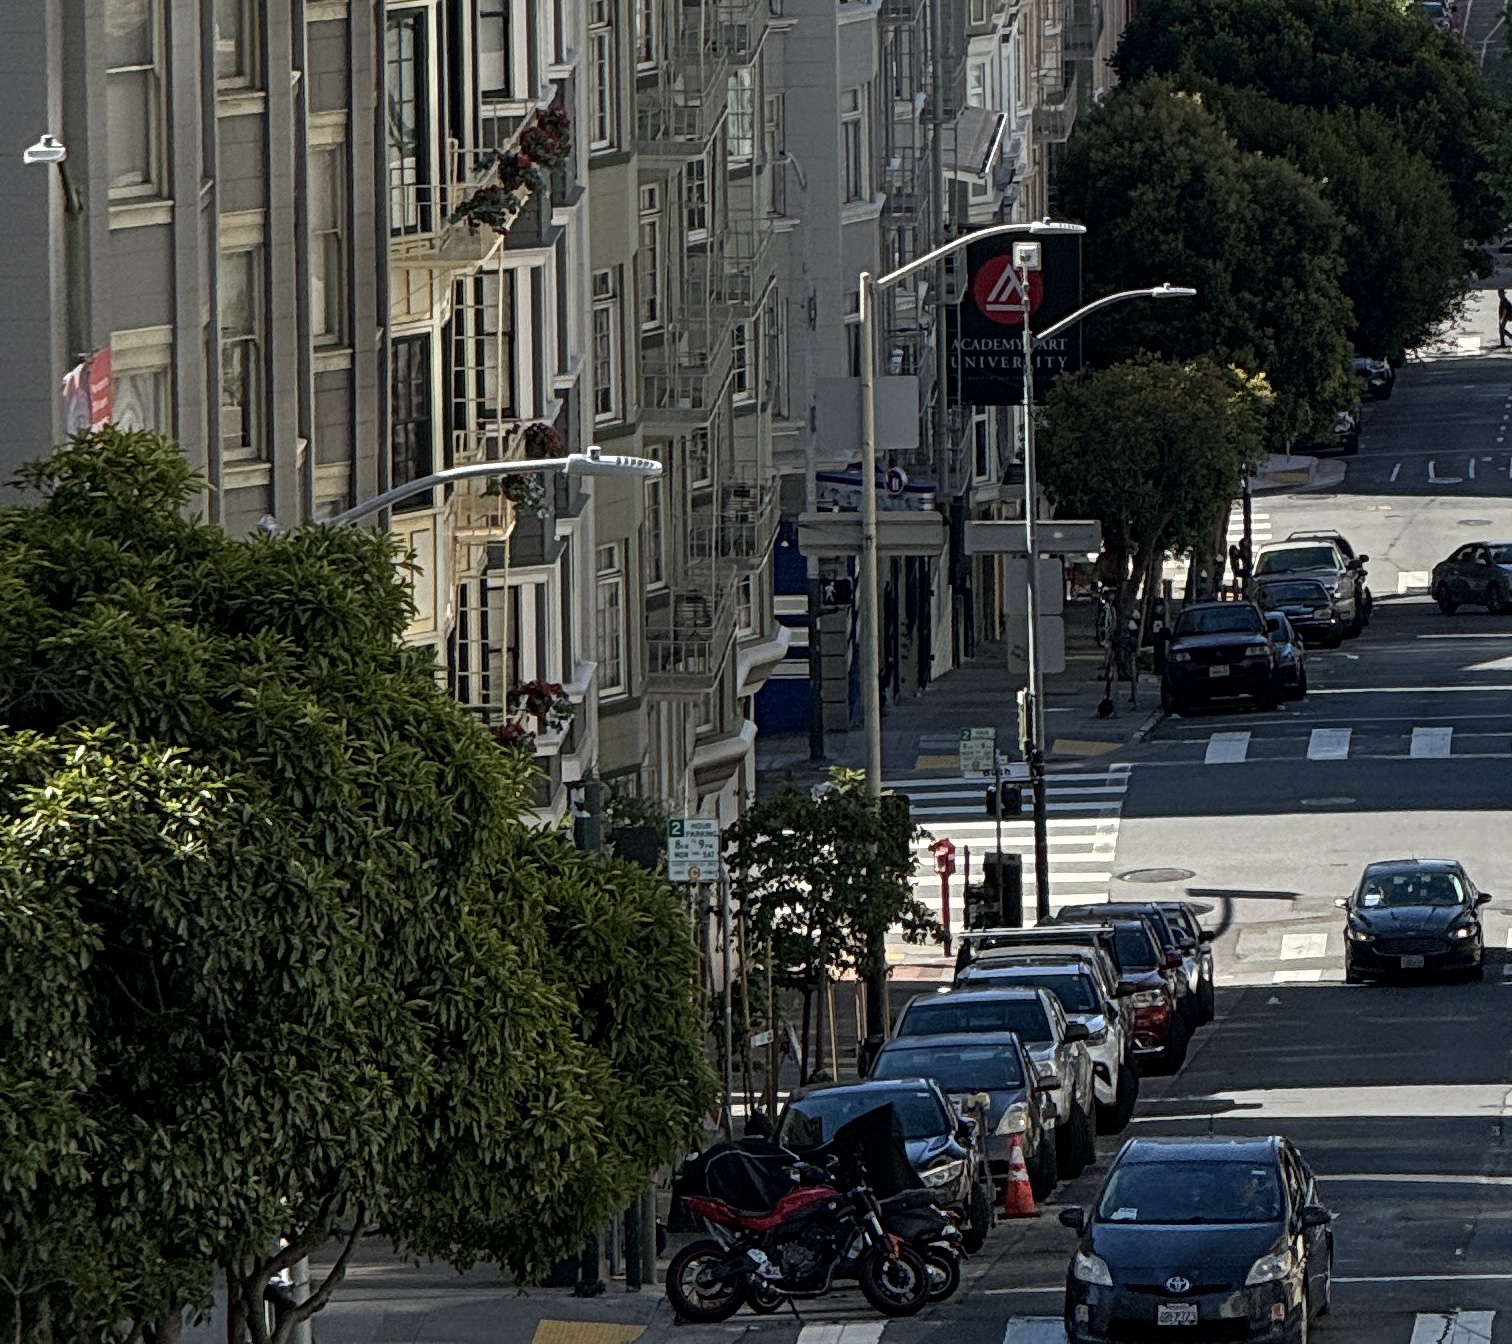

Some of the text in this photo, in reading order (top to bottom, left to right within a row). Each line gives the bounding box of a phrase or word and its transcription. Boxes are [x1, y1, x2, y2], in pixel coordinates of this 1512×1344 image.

[950, 338, 1068, 351] ACADEMY ART
[950, 356, 1068, 369] UNIVERITY
[671, 822, 682, 835] 2
